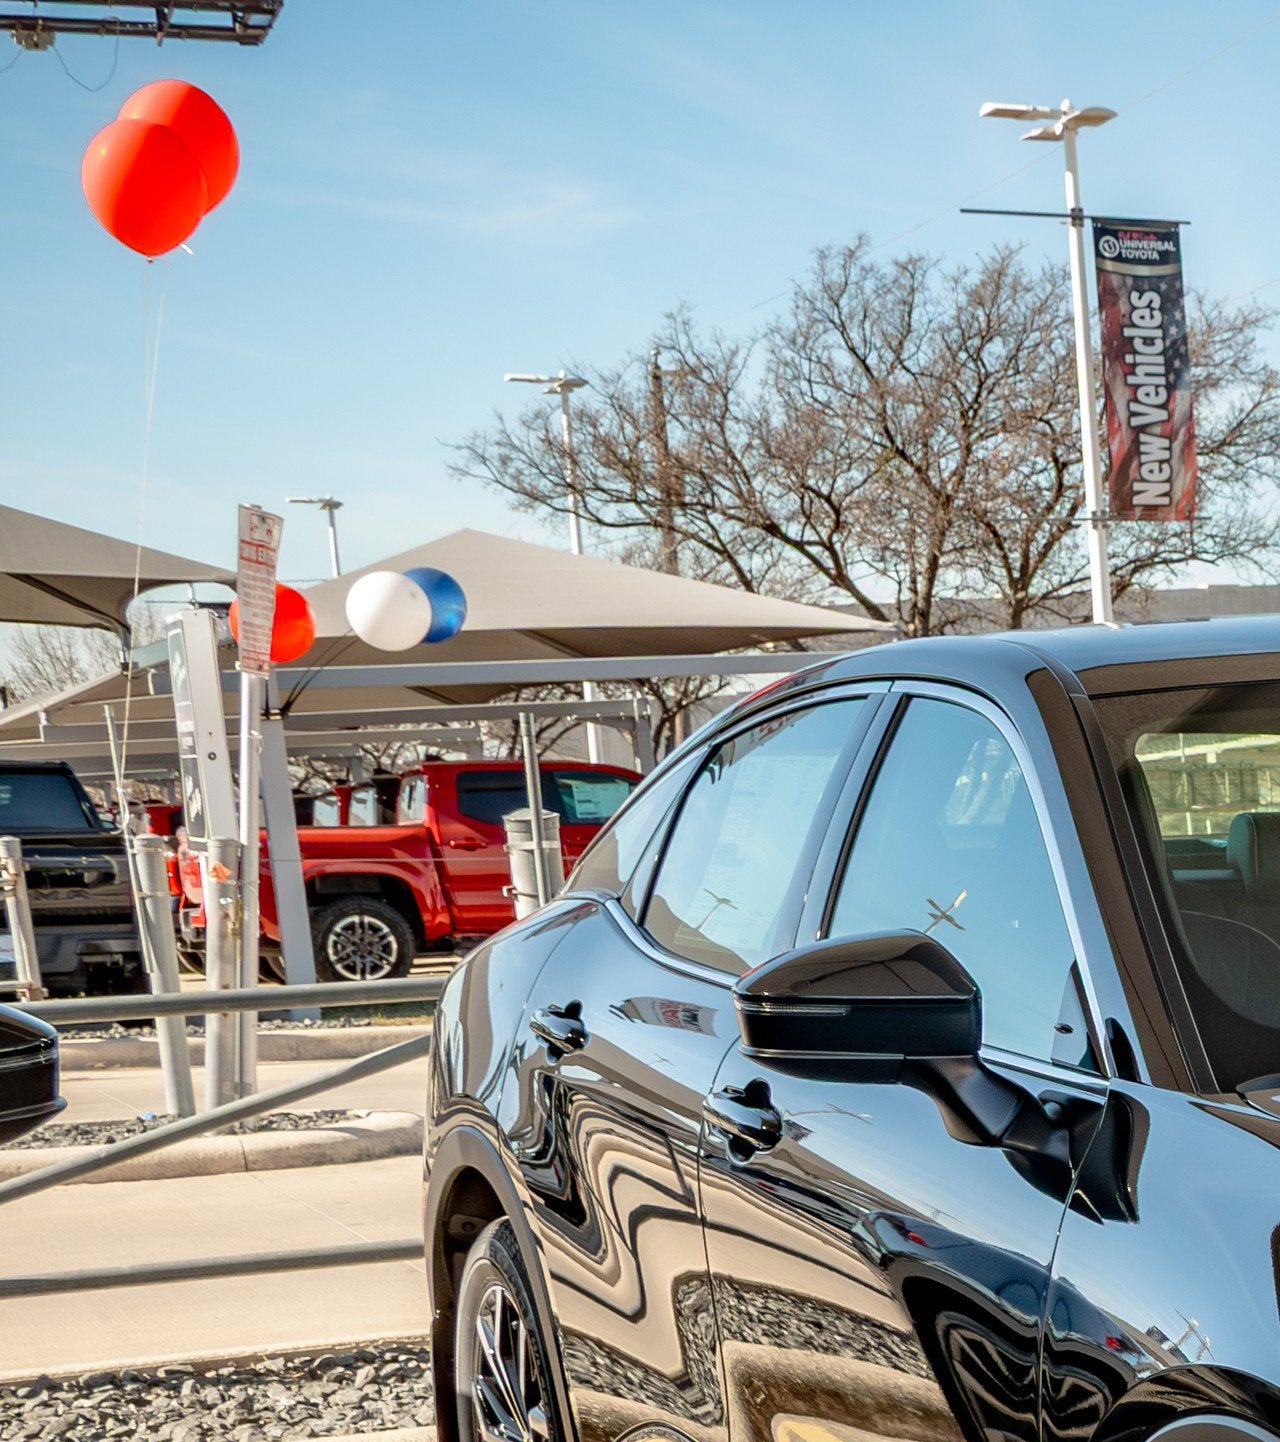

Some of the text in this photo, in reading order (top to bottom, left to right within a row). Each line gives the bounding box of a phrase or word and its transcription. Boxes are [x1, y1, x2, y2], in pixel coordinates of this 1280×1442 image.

[1118, 239, 1176, 252] UNIVERSAL
[1120, 249, 1160, 261] TOYOTA
[1123, 289, 1170, 428] Vehicles
[1132, 433, 1171, 506] New
